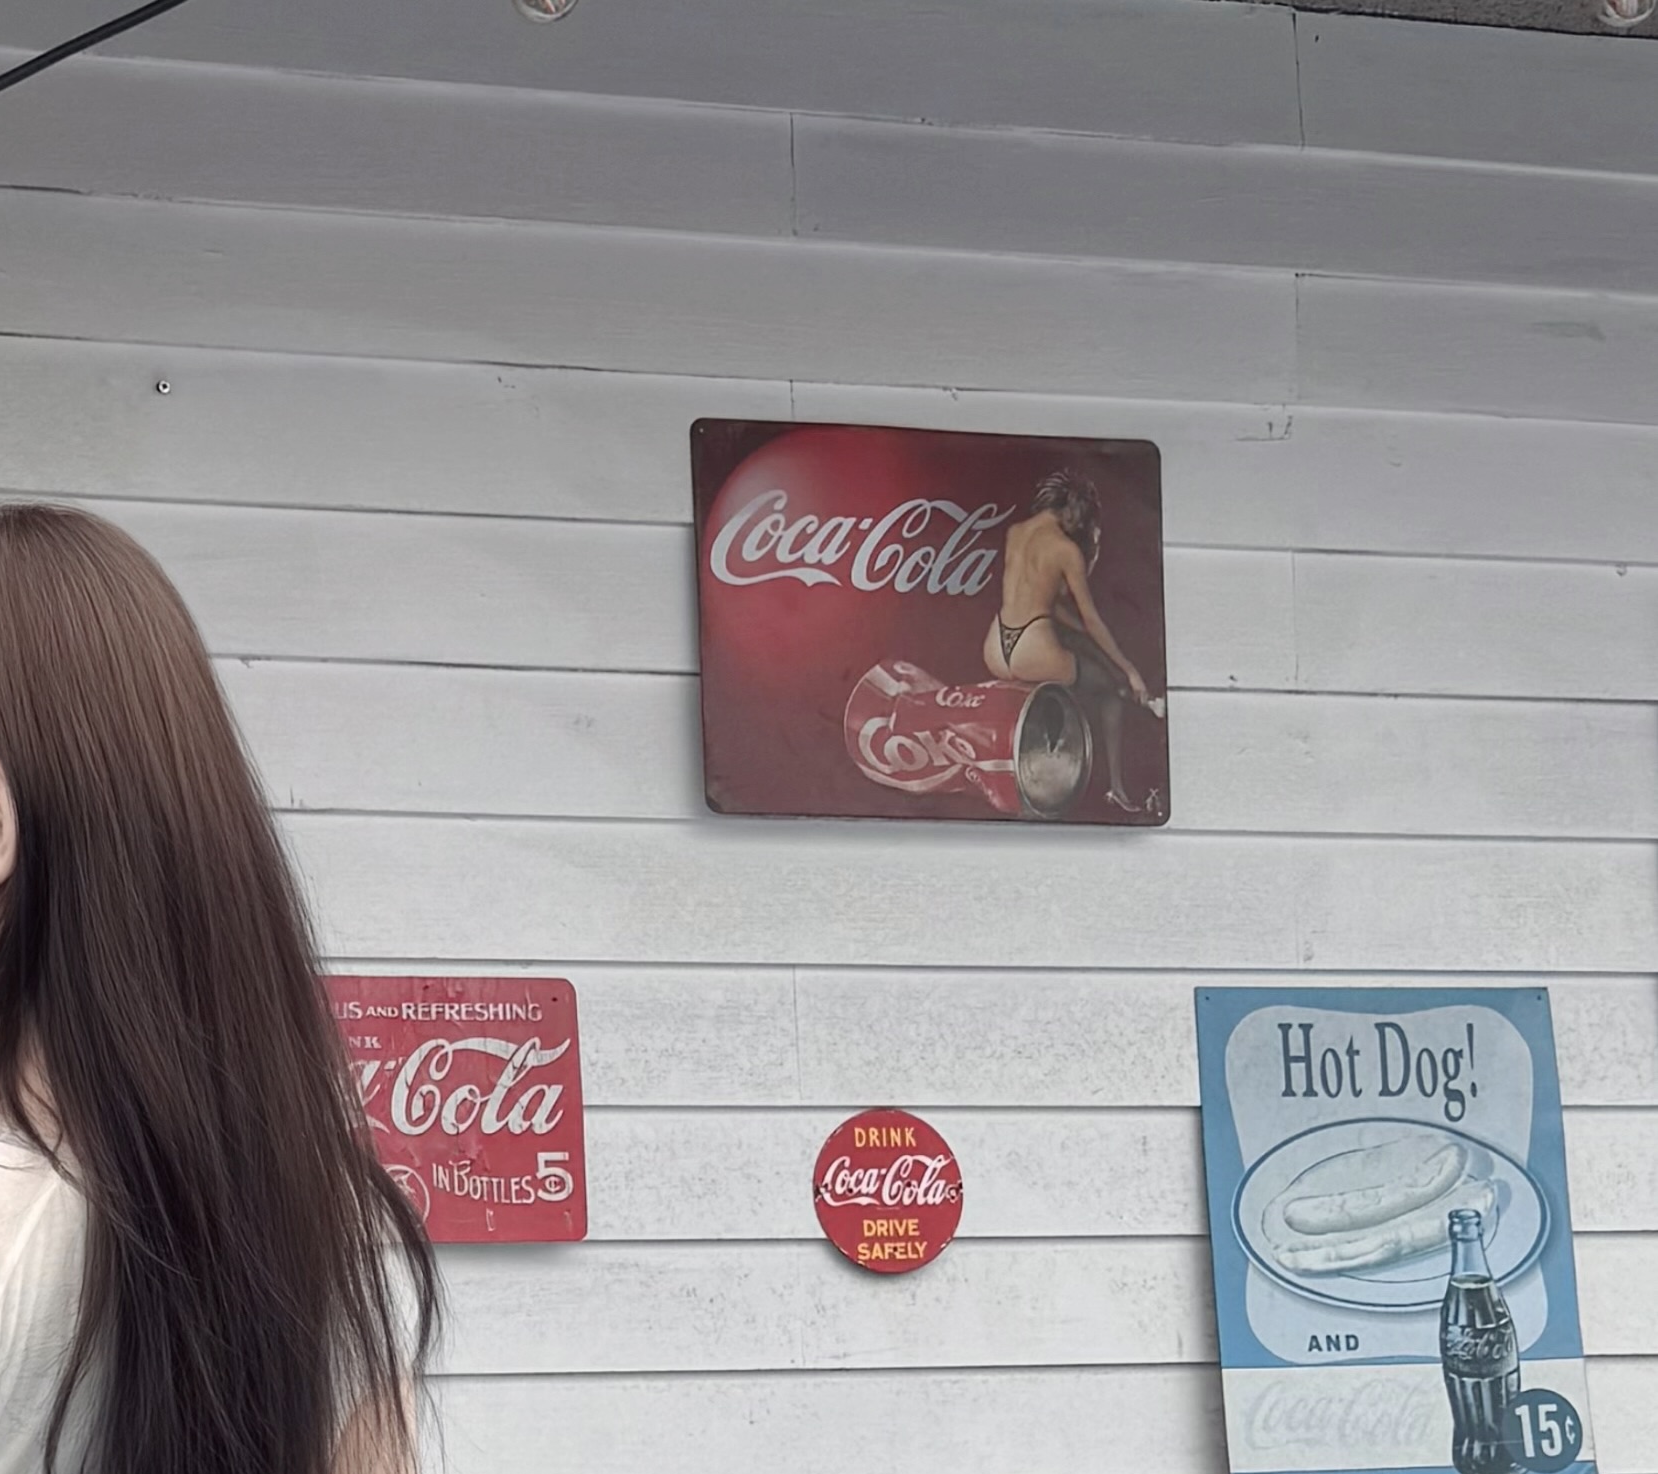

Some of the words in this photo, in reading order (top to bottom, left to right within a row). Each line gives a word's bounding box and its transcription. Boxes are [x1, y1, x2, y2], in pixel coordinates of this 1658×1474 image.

[710, 489, 1017, 596] Coca-Cola
[858, 716, 976, 775] Coke
[366, 1005, 399, 1018] AND
[401, 1002, 543, 1022] REFRESHING
[1277, 1022, 1363, 1099] Hot
[1374, 1021, 1478, 1122] Dog!
[854, 1127, 917, 1148] DRINK
[432, 1163, 451, 1192] IN
[821, 1154, 954, 1207] Coca-Cola
[863, 1218, 921, 1237] DRIVE
[857, 1241, 928, 1260] SAFELY
[1307, 1333, 1361, 1353] AND
